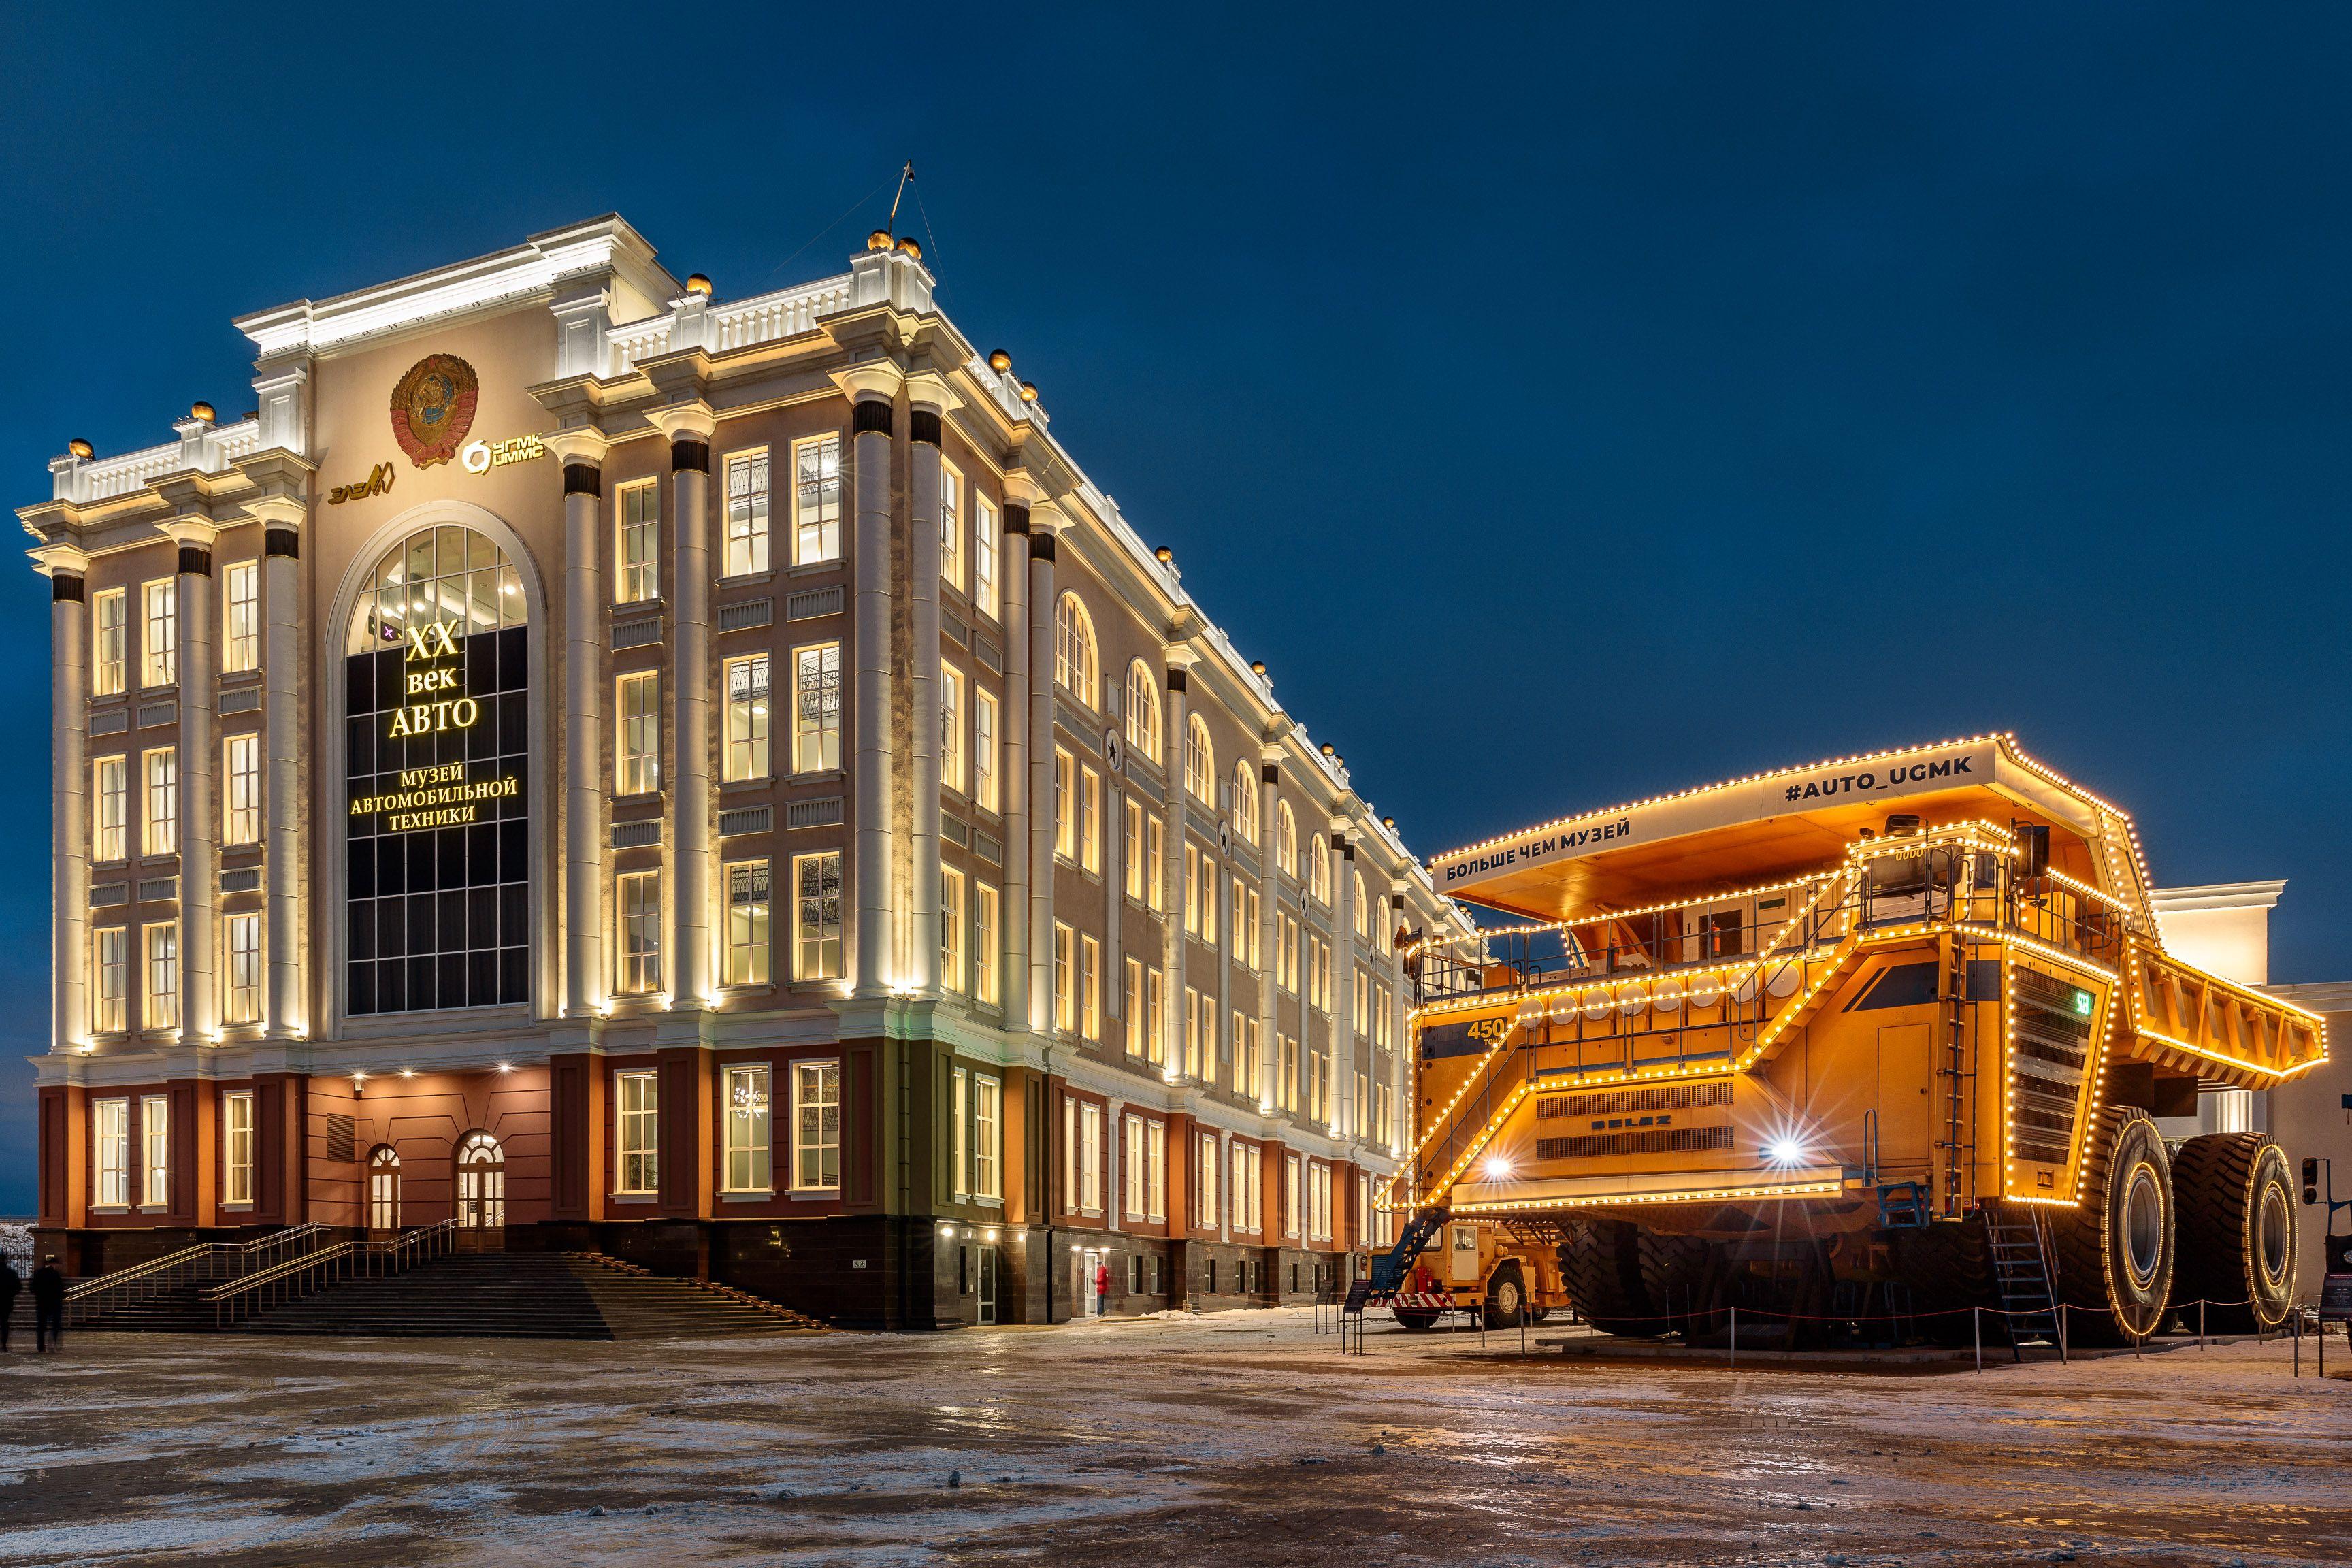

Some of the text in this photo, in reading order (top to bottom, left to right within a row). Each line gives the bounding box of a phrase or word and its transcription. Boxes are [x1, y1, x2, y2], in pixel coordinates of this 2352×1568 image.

[407, 667, 457, 694] век
[389, 698, 478, 738] АВТО
[401, 762, 463, 788] МУЗЕЙ
[1784, 755, 1972, 802] #AUTO_UGMK
[350, 776, 517, 815] АВТОМОБИЛЬНОЙ
[389, 806, 475, 830] ТЕХНИКИ
[1446, 817, 1631, 881] БОЛЬШЕ ЧЕМ МУЗЕЙ
[1467, 1019, 1505, 1039] 450
[1591, 1115, 1671, 1130] BELAZ
